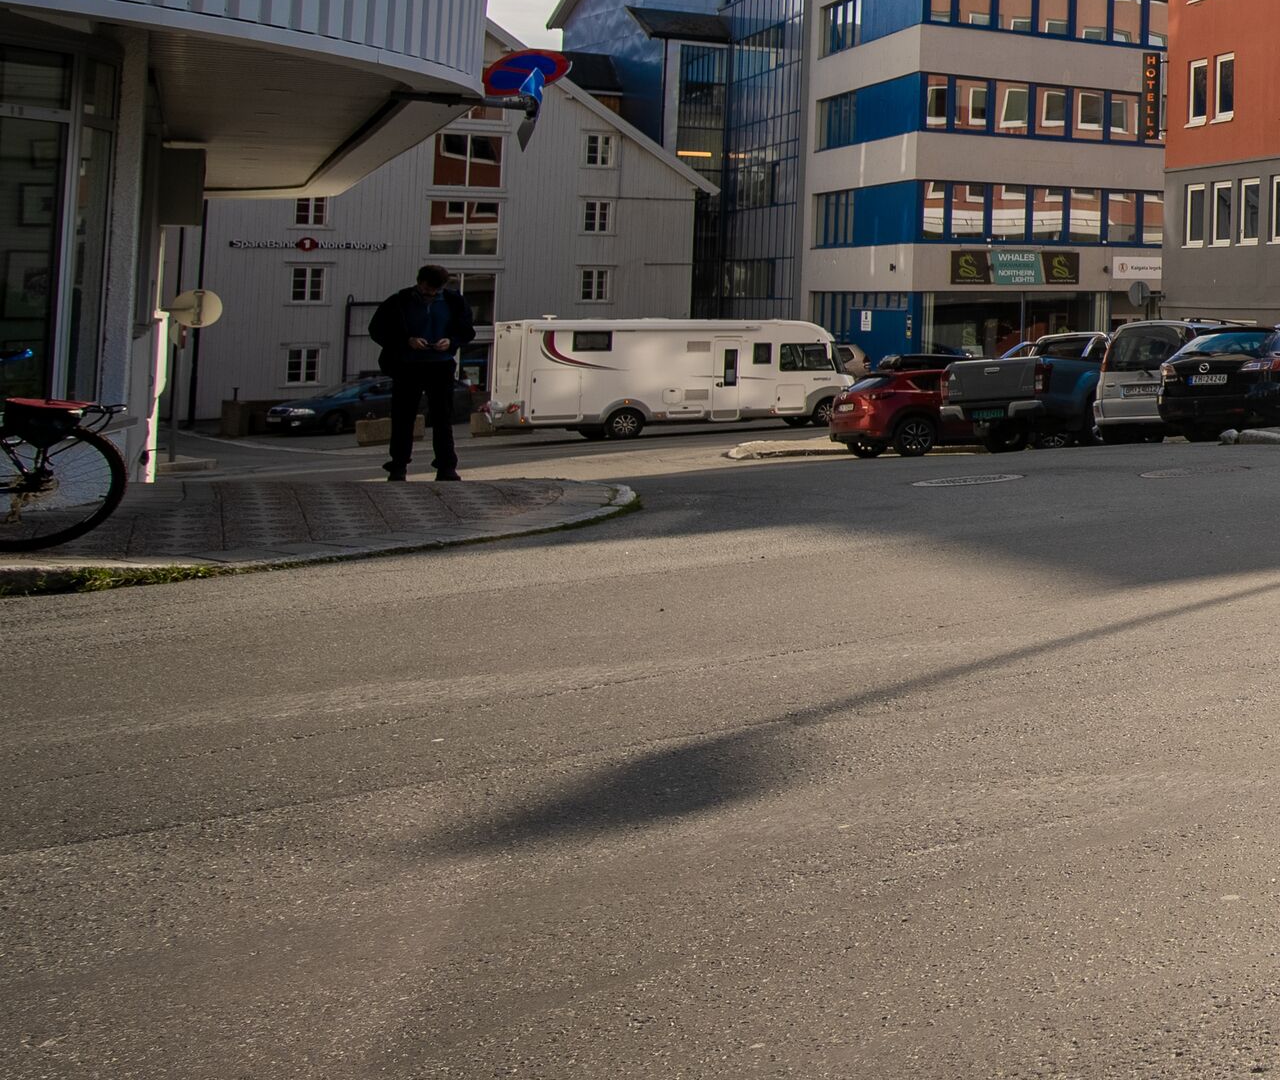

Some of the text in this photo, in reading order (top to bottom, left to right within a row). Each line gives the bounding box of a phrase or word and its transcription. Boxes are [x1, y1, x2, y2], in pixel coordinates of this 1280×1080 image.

[1145, 55, 1156, 127] HOTELL
[232, 239, 385, 252] SpareBank 1 Nord-Norge
[998, 253, 1035, 262] WHALES
[998, 269, 1035, 277] NORTHERN
